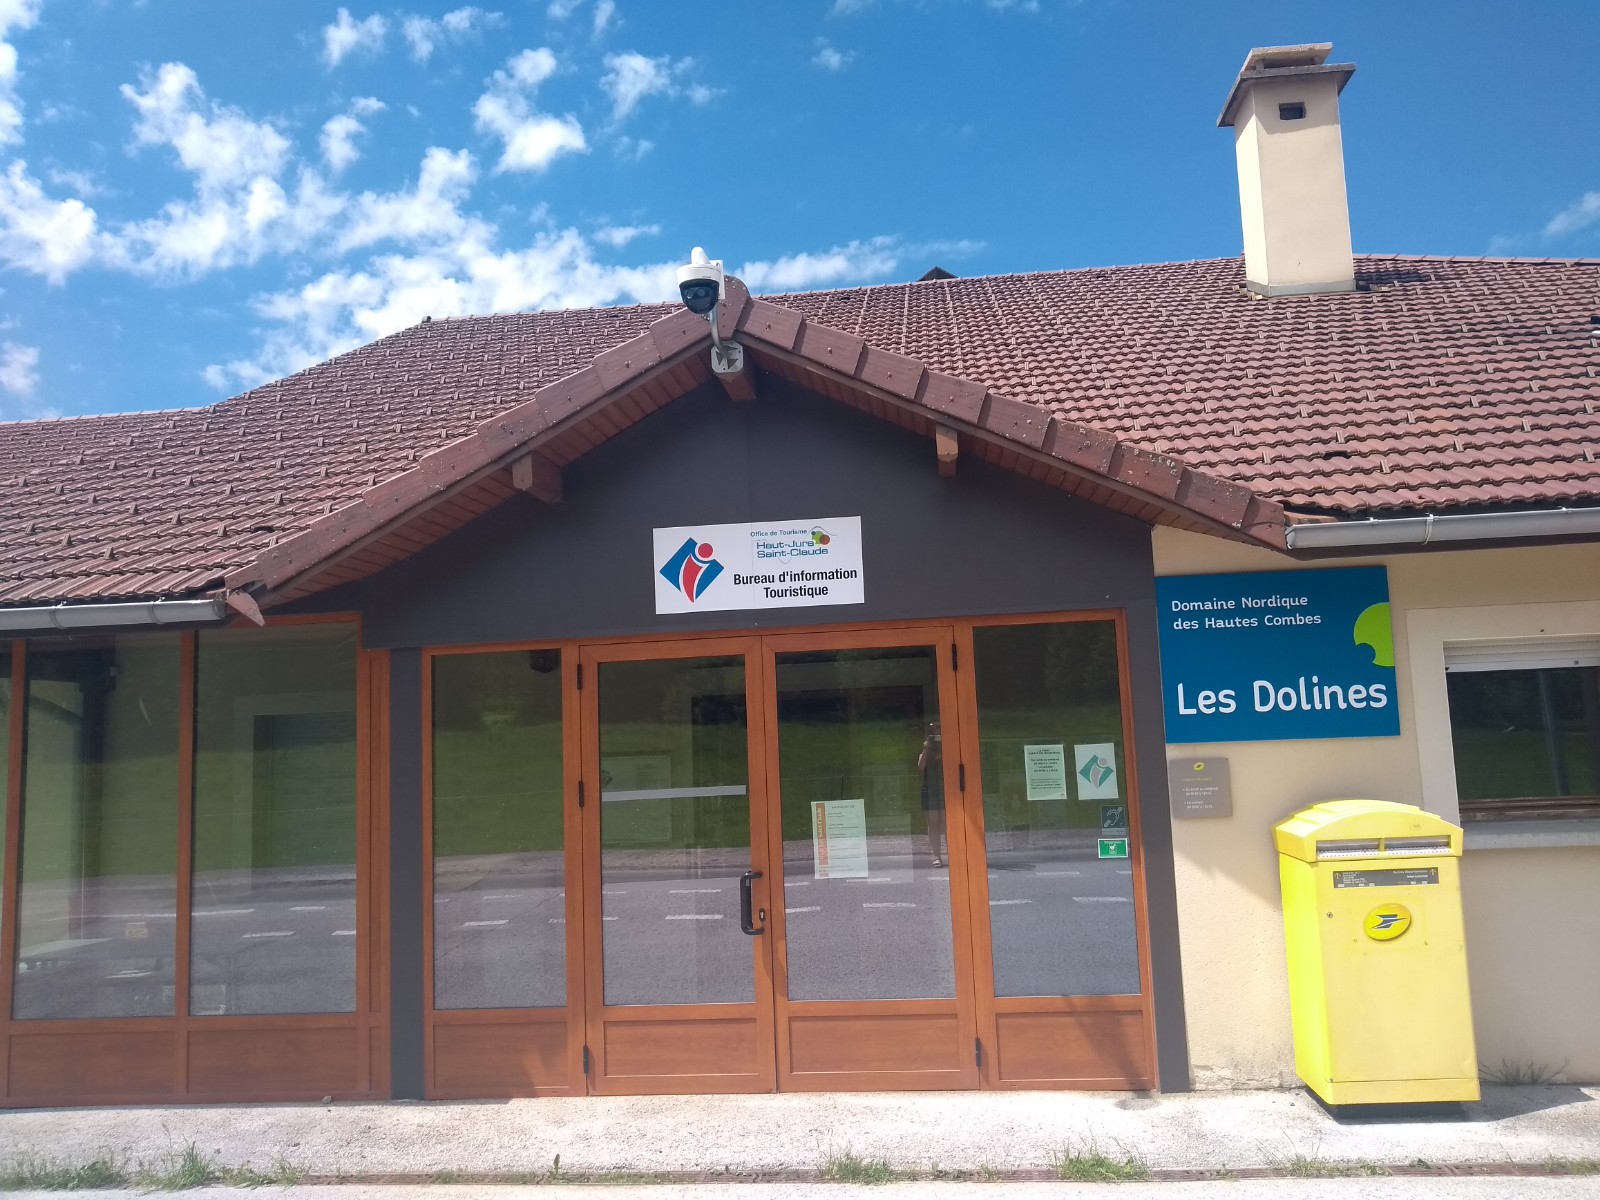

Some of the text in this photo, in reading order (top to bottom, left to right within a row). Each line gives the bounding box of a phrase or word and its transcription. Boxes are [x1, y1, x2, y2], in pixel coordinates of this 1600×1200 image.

[778, 528, 807, 536] Tourisme
[756, 540, 814, 550] Haut-Jura
[757, 547, 828, 558] Saint-Claude
[733, 567, 857, 585] Bureau d'information
[763, 584, 829, 599] Touristique
[1171, 595, 1308, 612] Domaine Nordique
[1173, 613, 1321, 630] des Hautes Combes
[1177, 675, 1388, 715] Les Dolines
